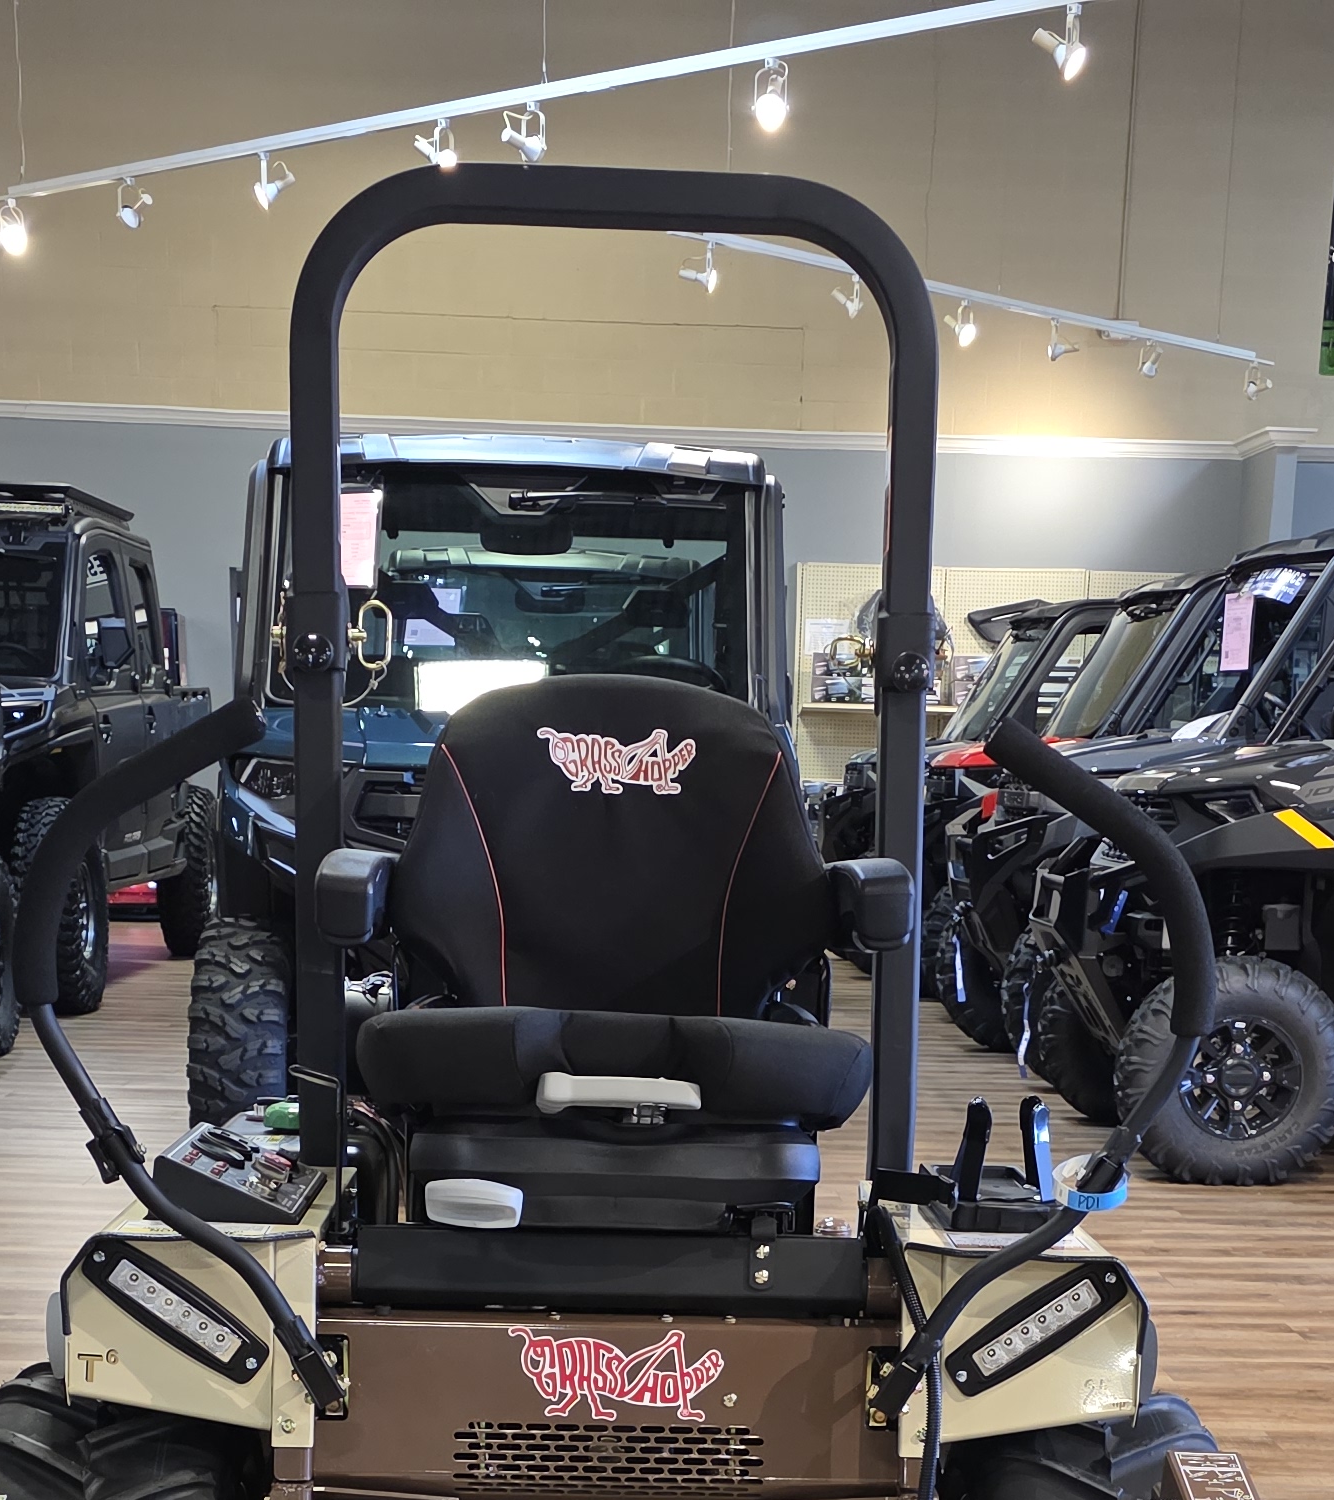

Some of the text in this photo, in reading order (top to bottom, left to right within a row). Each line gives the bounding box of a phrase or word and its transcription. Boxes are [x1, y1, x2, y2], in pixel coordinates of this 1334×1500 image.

[547, 730, 695, 792] GRASSHOPPER
[1077, 1195, 1101, 1209] PDI
[515, 1331, 724, 1416] GRASSHOPPER
